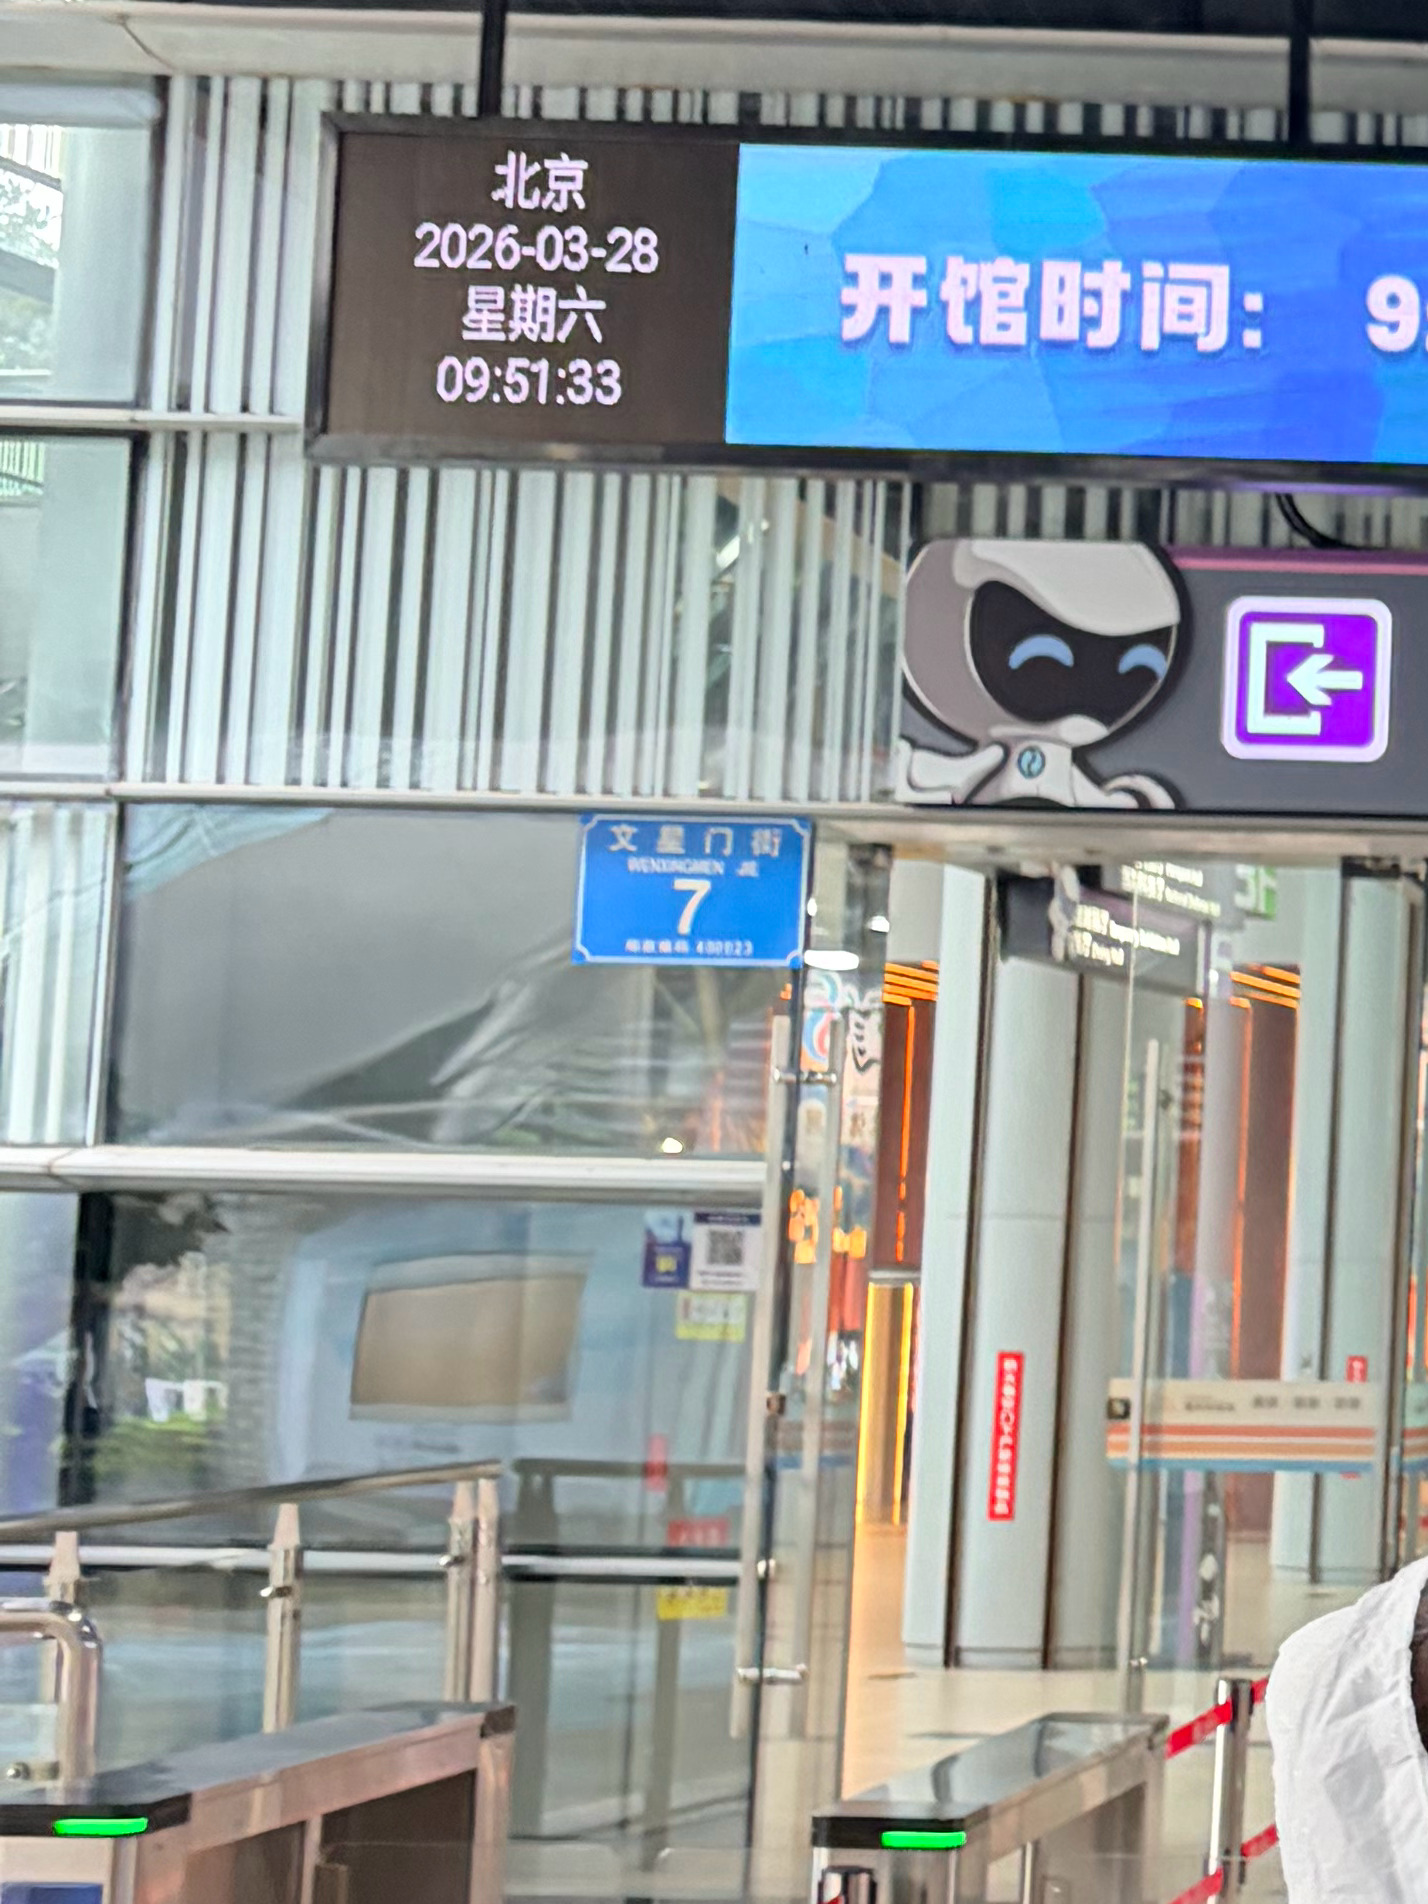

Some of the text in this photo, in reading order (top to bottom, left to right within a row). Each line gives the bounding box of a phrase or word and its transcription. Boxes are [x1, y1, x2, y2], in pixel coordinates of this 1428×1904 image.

[490, 150, 589, 213] 北京
[413, 221, 660, 274] 2026-03-28
[461, 283, 607, 346] 星期六
[840, 252, 1265, 353] 开馆时间：
[435, 355, 622, 407] 09:51:33
[608, 823, 782, 857] 文星门街
[673, 877, 712, 936] 7
